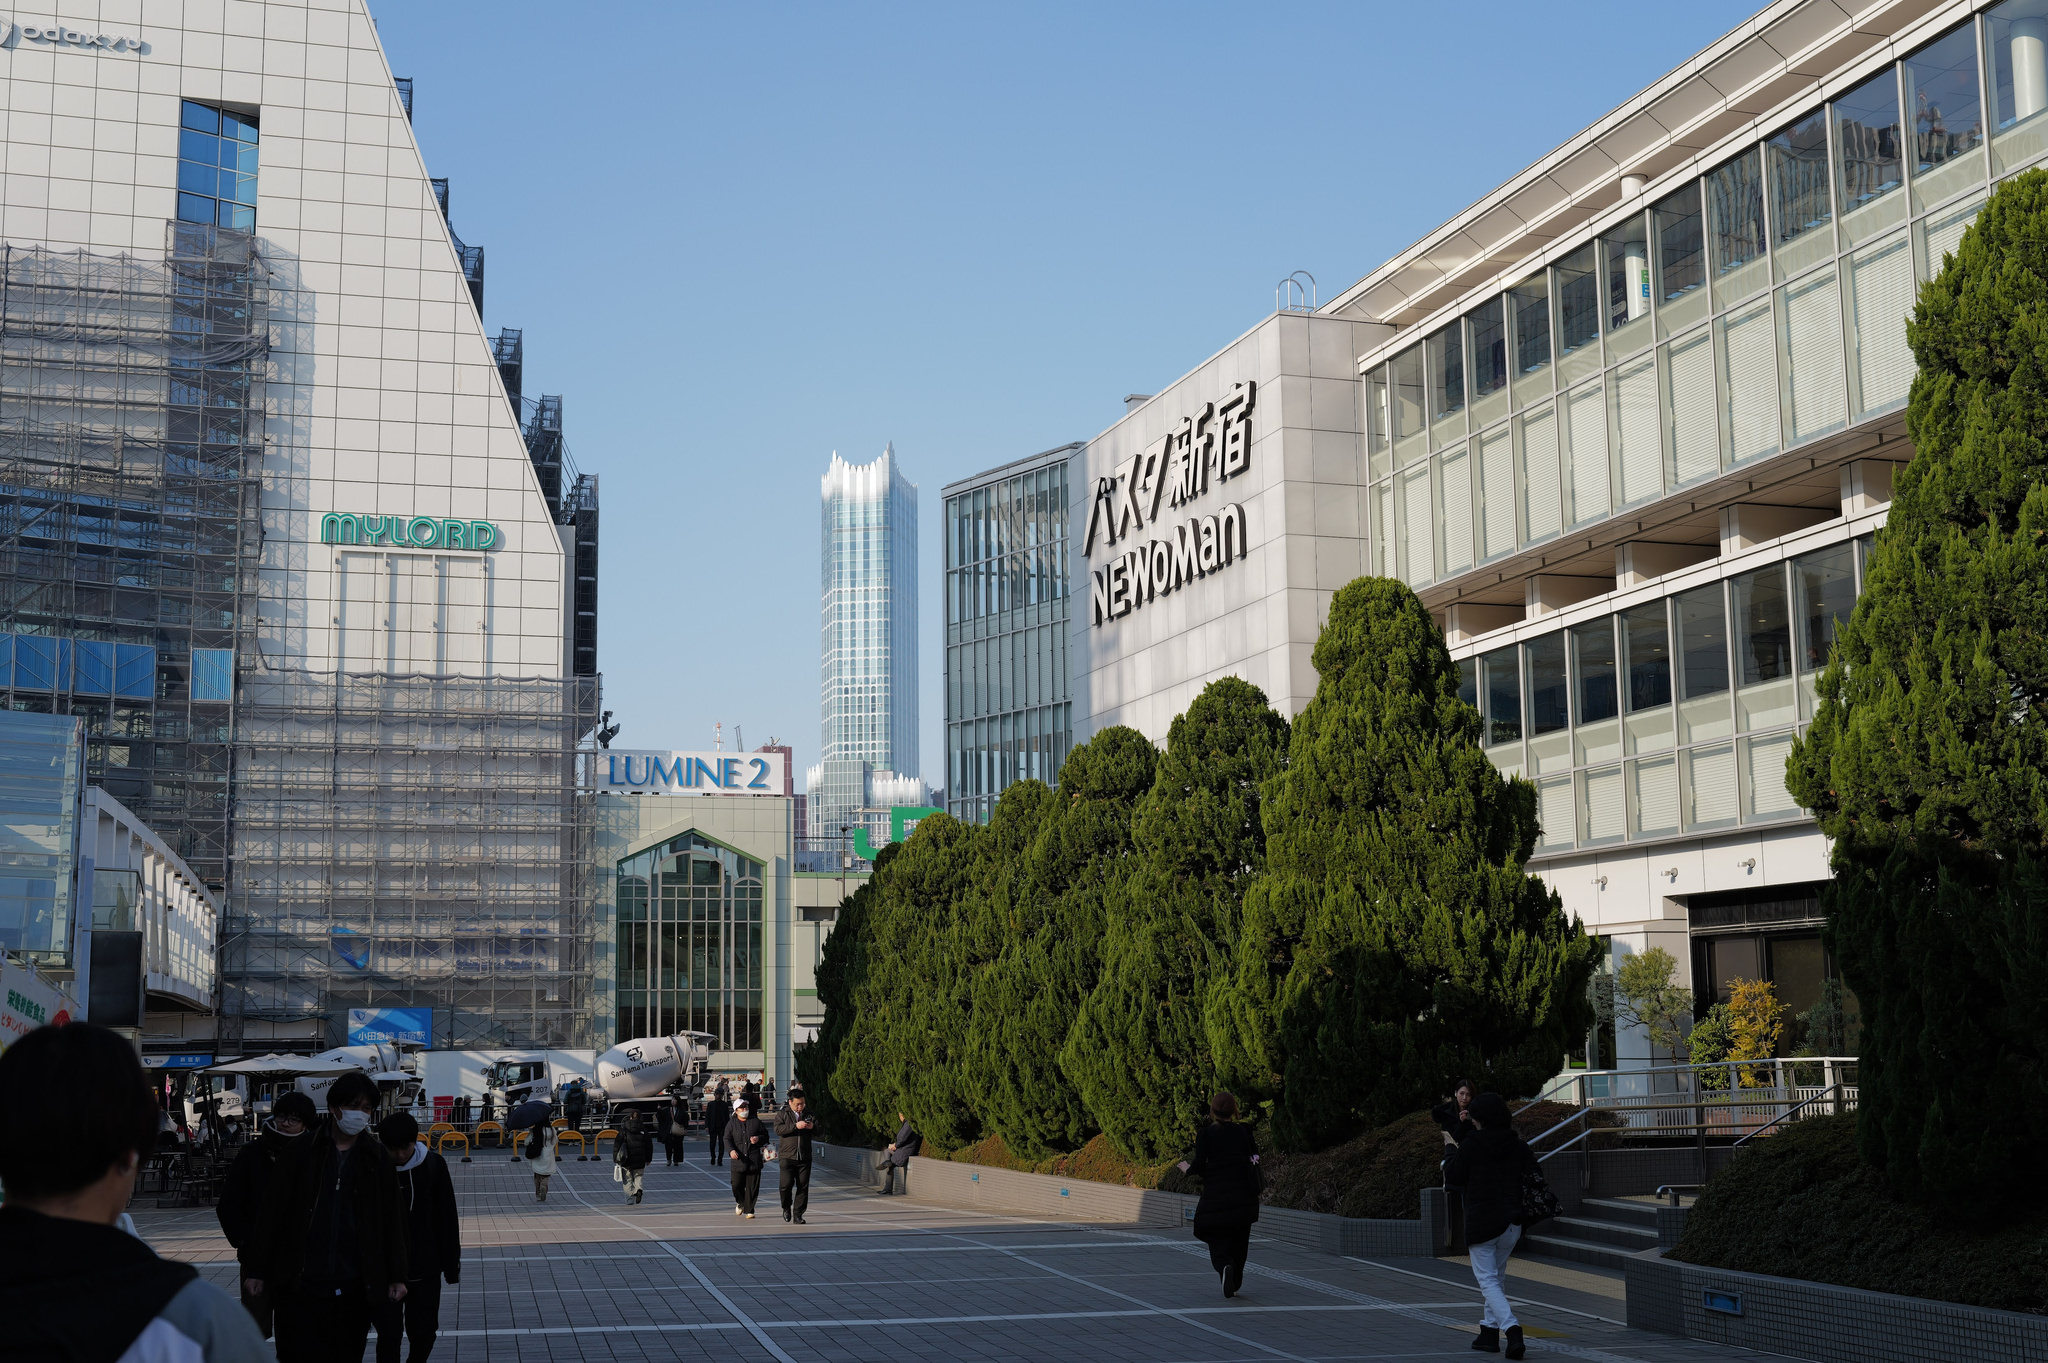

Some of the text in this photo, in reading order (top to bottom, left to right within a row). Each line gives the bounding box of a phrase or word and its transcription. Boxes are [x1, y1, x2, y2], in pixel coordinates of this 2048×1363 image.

[1082, 380, 1257, 557] バスタ新宿
[321, 512, 497, 549] MYLORD
[609, 755, 767, 788] LUMINE 2
[226, 1097, 240, 1105] 279
